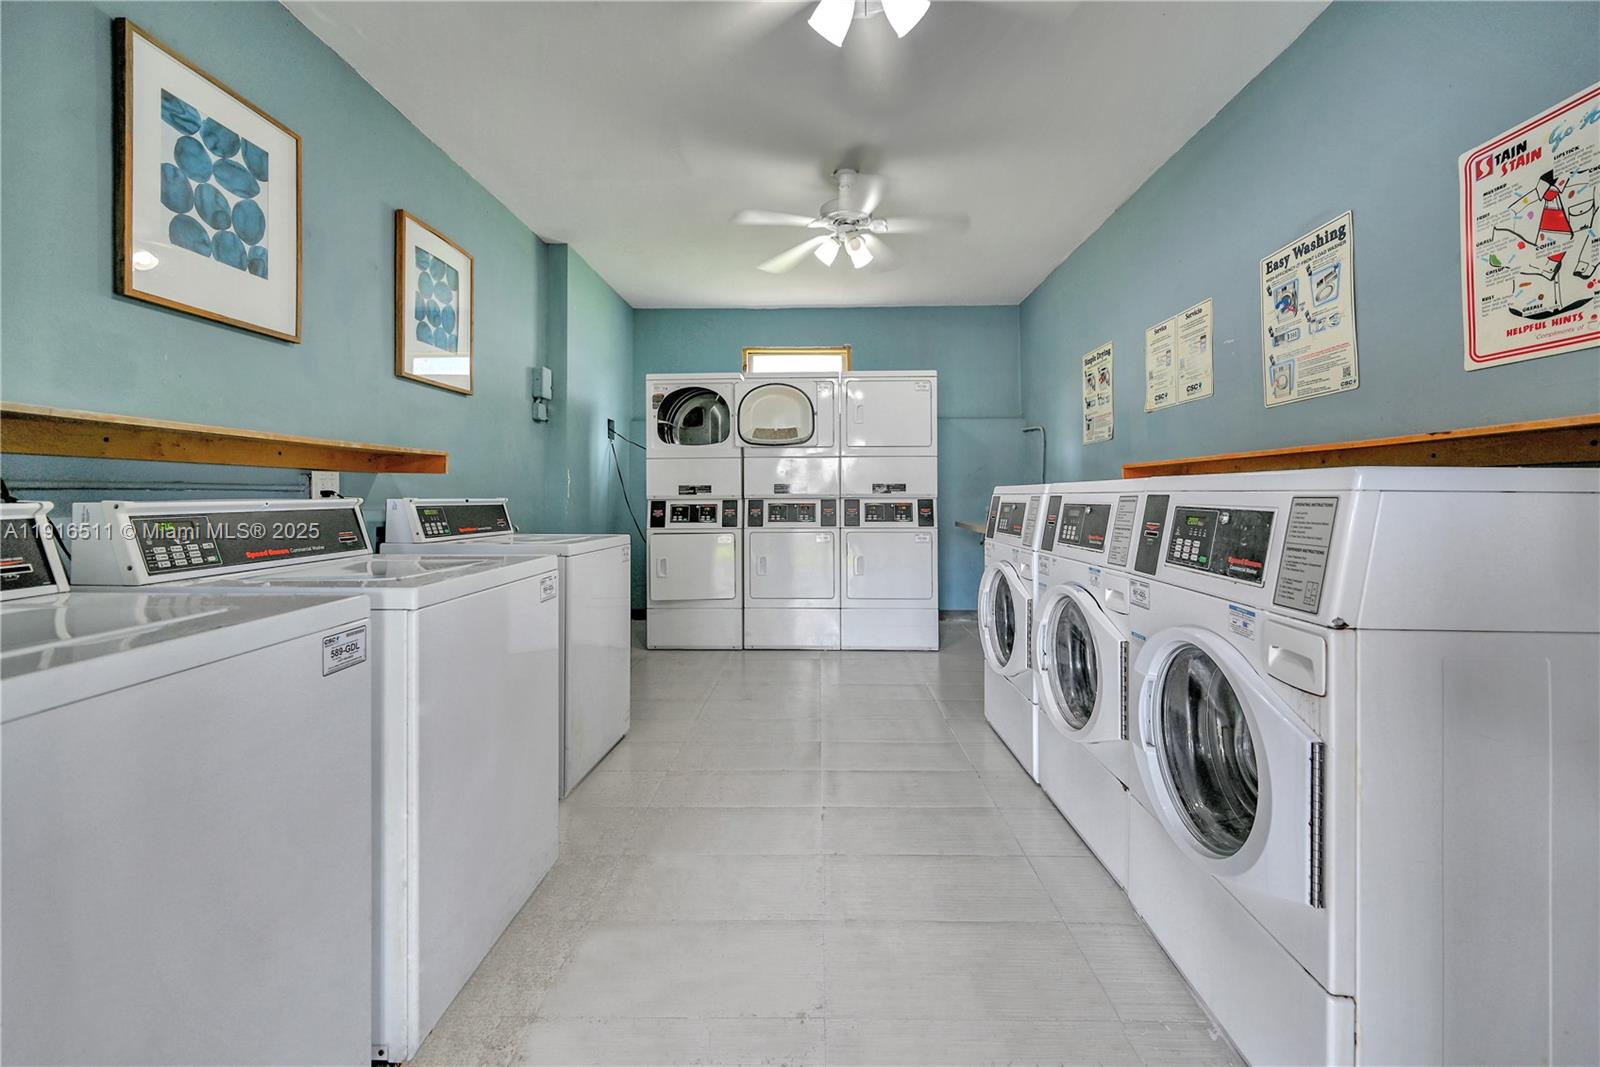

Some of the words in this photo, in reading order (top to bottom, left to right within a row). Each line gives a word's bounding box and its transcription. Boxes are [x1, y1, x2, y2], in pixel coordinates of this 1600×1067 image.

[1554, 146, 1580, 160] LIPSTICK
[1501, 147, 1542, 177] STAIN
[1483, 183, 1507, 197] MUSTARD
[1265, 254, 1290, 275] Easy
[1292, 224, 1346, 260] Washing
[1536, 241, 1556, 250] COFFEE
[1506, 321, 1547, 337] HELPFUL
[1551, 312, 1584, 327] HINTS
[1186, 383, 1199, 392] CSC
[331, 642, 360, 659] 589-GDL
